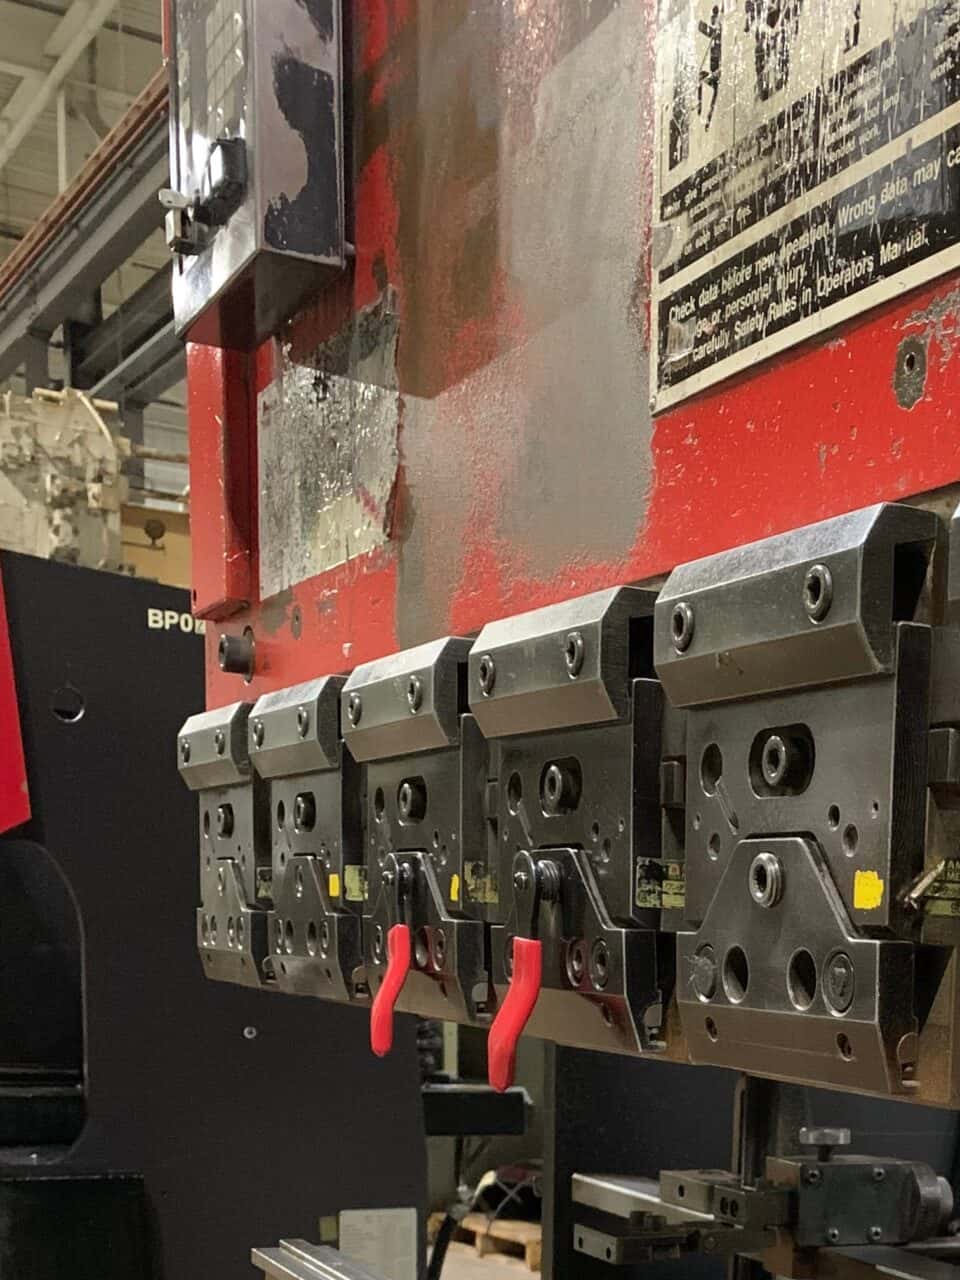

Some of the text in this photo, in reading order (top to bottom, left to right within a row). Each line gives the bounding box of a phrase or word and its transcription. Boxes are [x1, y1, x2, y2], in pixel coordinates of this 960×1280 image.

[669, 296, 695, 324] Check
[698, 282, 718, 307] data
[721, 265, 752, 293] before
[754, 253, 776, 274] new
[837, 198, 876, 228] Wrong
[880, 175, 907, 204] data
[913, 157, 940, 187] may
[692, 330, 729, 362] carefully
[734, 312, 764, 340] Safety
[802, 283, 811, 304] in
[817, 254, 874, 297] Operators
[726, 281, 771, 318] personnel
